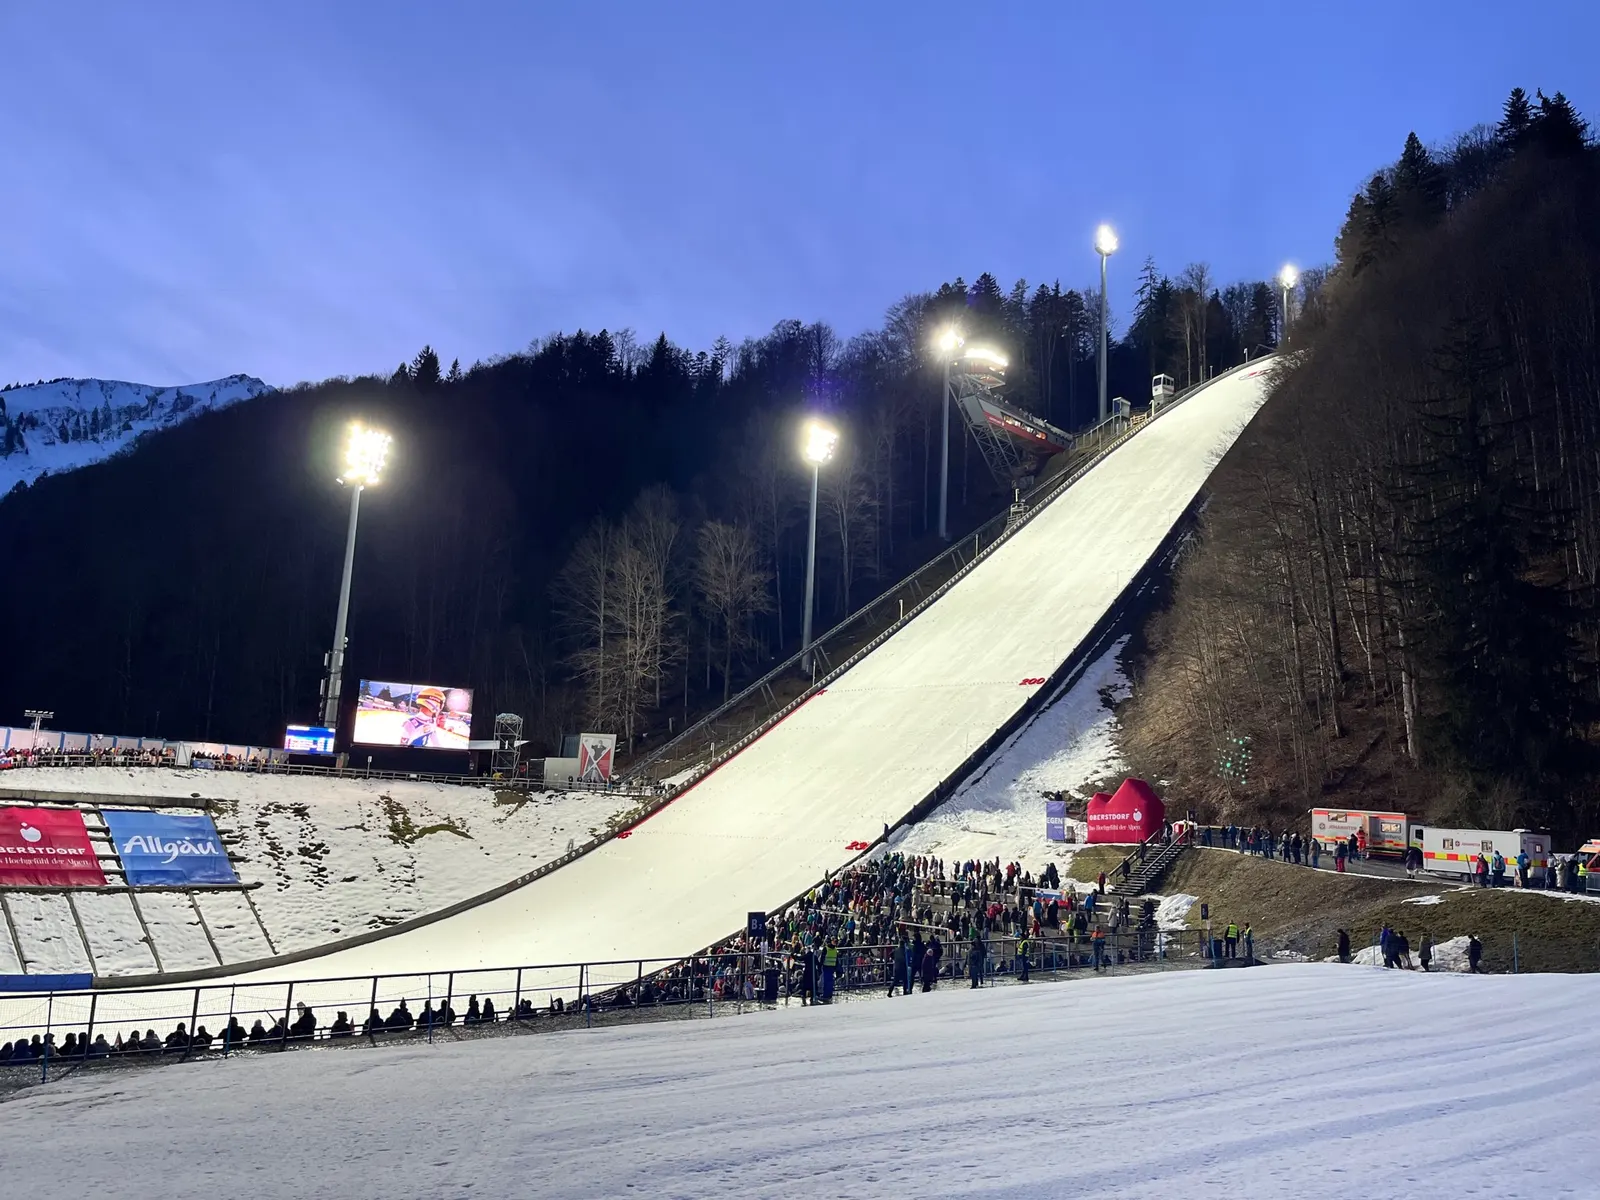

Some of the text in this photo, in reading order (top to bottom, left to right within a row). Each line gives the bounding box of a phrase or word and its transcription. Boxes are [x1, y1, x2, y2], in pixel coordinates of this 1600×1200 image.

[1018, 677, 1046, 686] 200
[1089, 813, 1131, 821] OBERSTDORF
[122, 835, 219, 864] Allgäu
[51, 857, 65, 865] der
